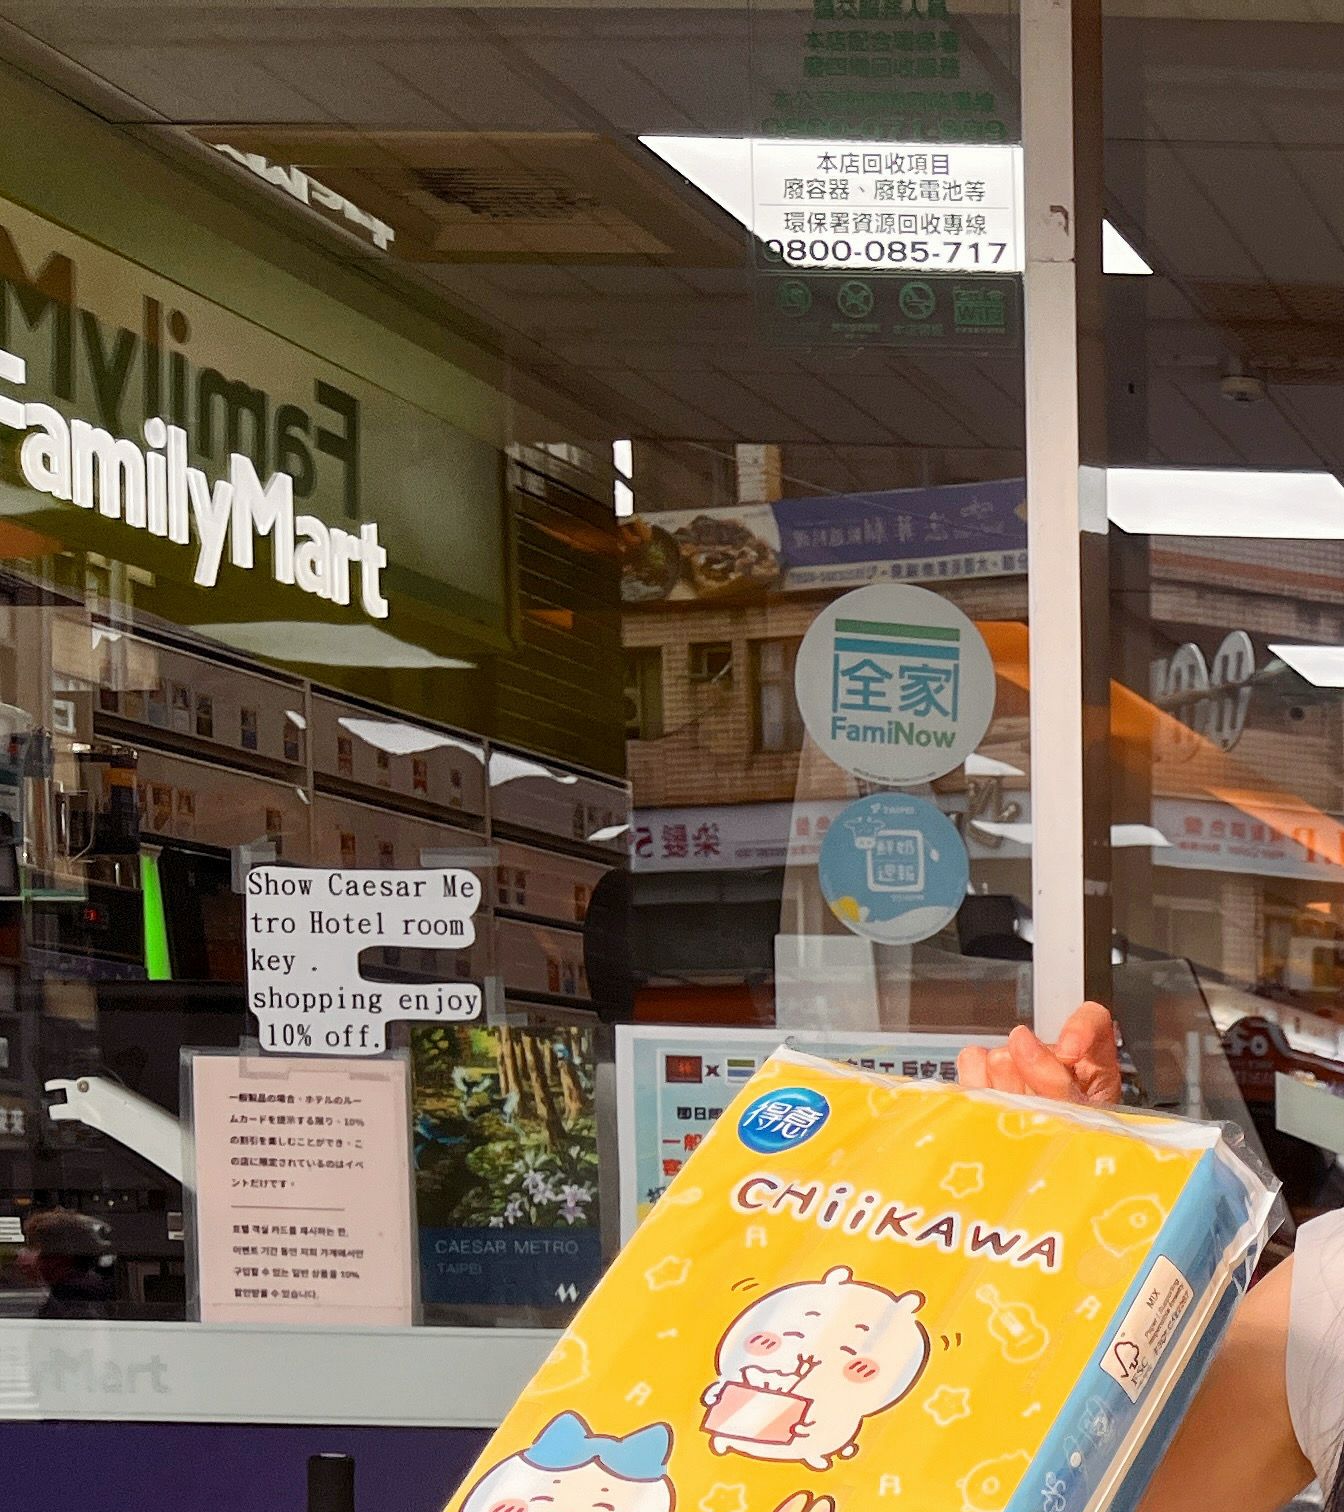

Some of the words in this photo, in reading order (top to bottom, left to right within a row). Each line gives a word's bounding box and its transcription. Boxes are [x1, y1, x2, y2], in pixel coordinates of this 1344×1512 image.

[817, 152, 950, 176] 本店回收項目
[784, 178, 986, 202] 廢容器、廢乾電池等
[784, 211, 988, 235] 環保署資源回收專線
[764, 239, 1008, 264] 0800-085-717
[841, 658, 952, 718] 全家
[831, 715, 957, 749] FamiNow
[248, 873, 313, 897] Show
[328, 874, 427, 898] Caesar
[442, 876, 475, 898] Me
[250, 913, 296, 935] tro
[309, 911, 386, 936] Hotel
[402, 917, 465, 936] room
[251, 948, 296, 975] key
[253, 987, 383, 1014] shopping
[398, 988, 480, 1016] enjoy
[266, 1024, 313, 1047] 10%
[326, 1022, 381, 1049] off.
[743, 1100, 825, 1139] 得意
[434, 1239, 507, 1255] CAESAR
[513, 1240, 580, 1255] METRO
